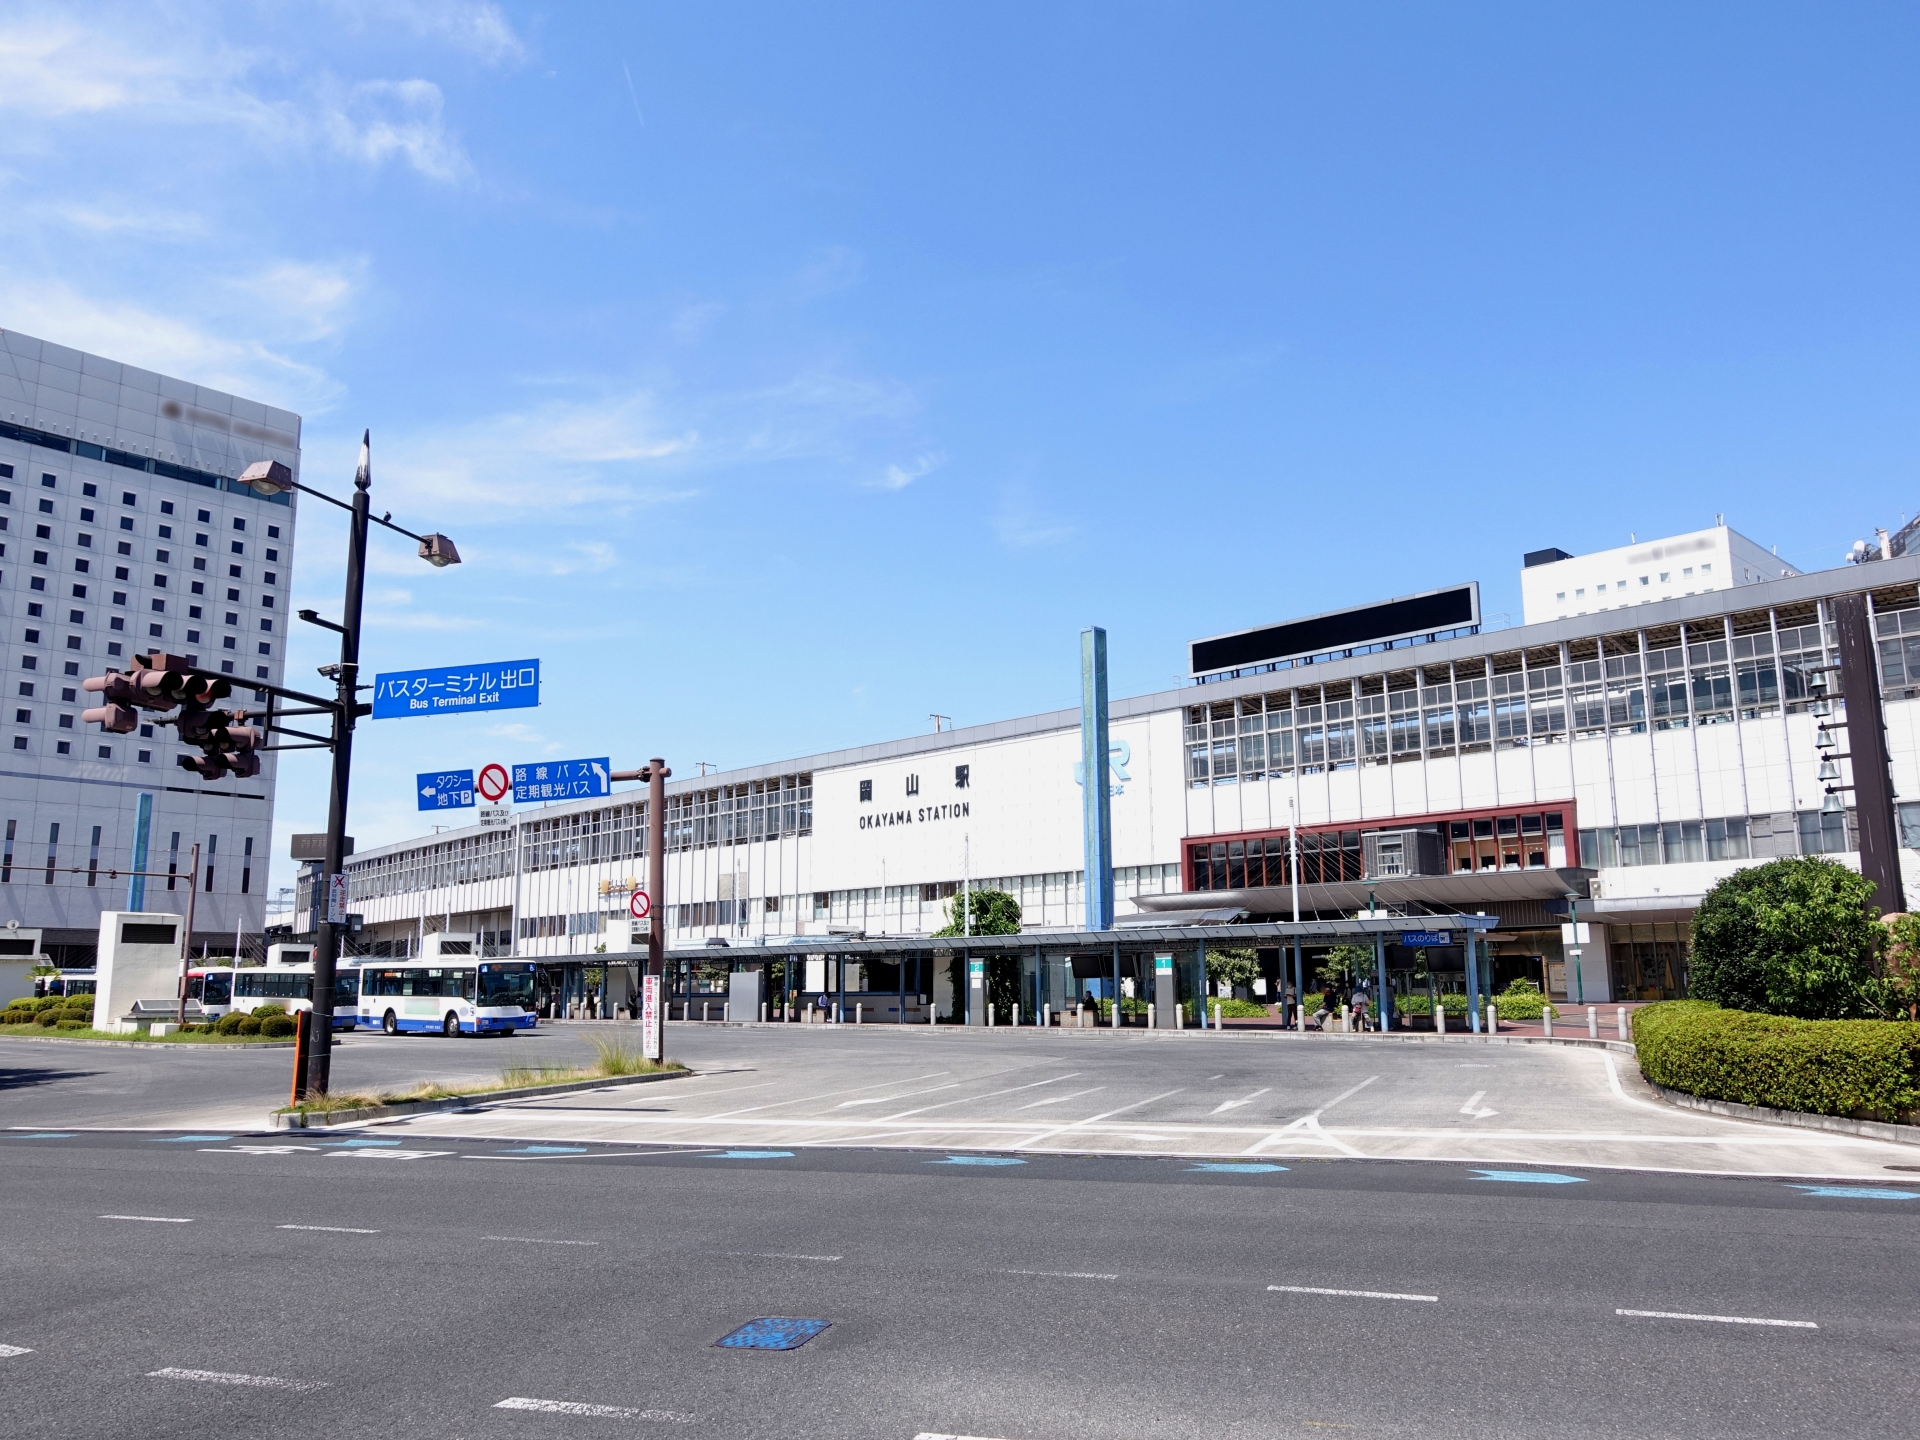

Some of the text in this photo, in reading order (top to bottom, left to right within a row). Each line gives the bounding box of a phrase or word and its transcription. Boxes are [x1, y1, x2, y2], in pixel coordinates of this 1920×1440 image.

[378, 668, 535, 699] バスターミナル出口
[410, 692, 499, 709] Bus Terminal Exit
[436, 775, 471, 789] タクシー
[515, 781, 590, 800] 定期観光バス
[860, 802, 969, 830] OKAYAMA STATION
[1404, 934, 1438, 942] バスのりば
[1161, 959, 1166, 968] 1
